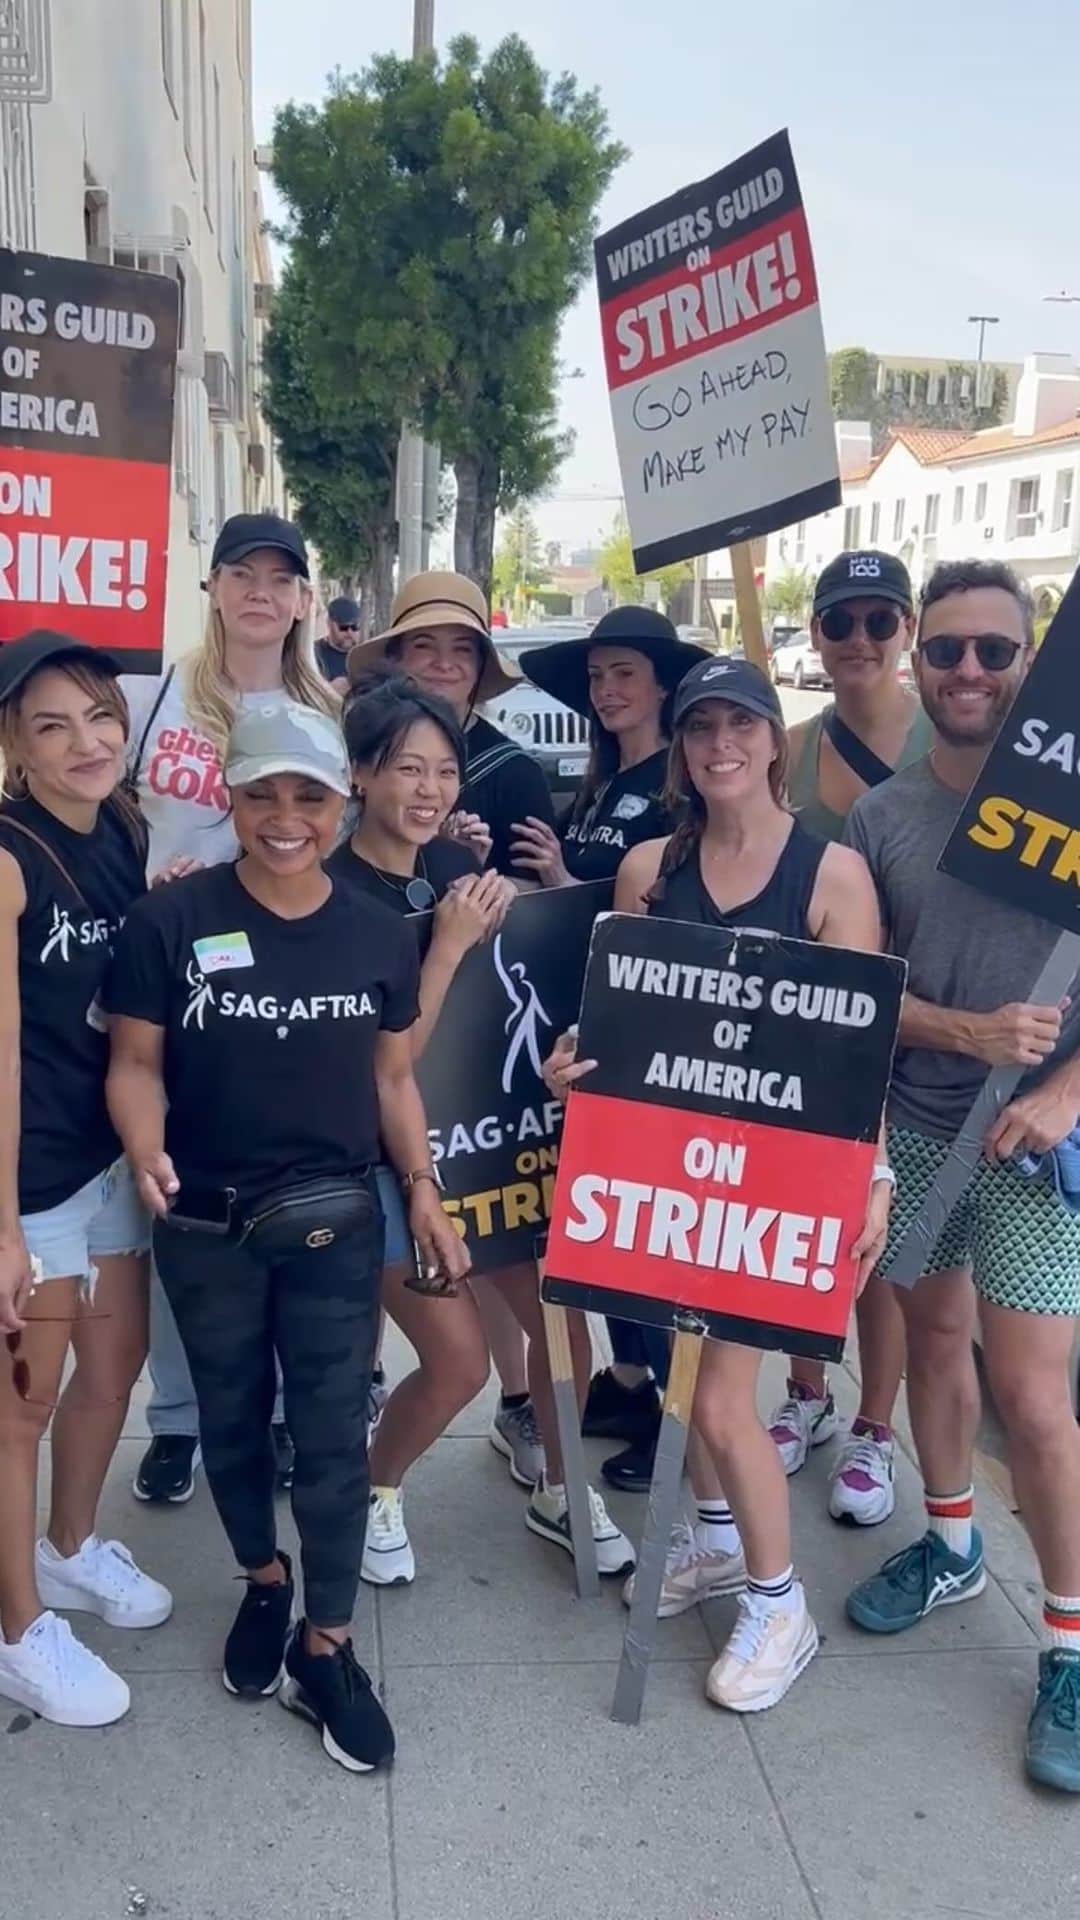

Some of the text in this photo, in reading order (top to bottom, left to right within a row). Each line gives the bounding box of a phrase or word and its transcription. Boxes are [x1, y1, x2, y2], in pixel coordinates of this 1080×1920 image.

[607, 167, 784, 281] WRITERS GUILD
[686, 245, 710, 272] ON
[616, 231, 801, 371] STRIKE!
[55, 302, 155, 349] GUILD
[2, 346, 40, 379] OF
[0, 391, 100, 437] ERICA
[633, 351, 791, 431] GO AHEAD,
[643, 446, 705, 493] MAKE
[716, 424, 752, 460] MY
[0, 471, 52, 518] ON
[159, 728, 221, 765] che
[1013, 718, 1080, 776] SA
[608, 953, 876, 1028] WRITERS GUILD
[713, 1020, 752, 1051] OF
[644, 1052, 803, 1111] AMERICA
[516, 1144, 558, 1175] ON
[684, 1138, 747, 1186] ON
[564, 1173, 843, 1293] STRIKE!
